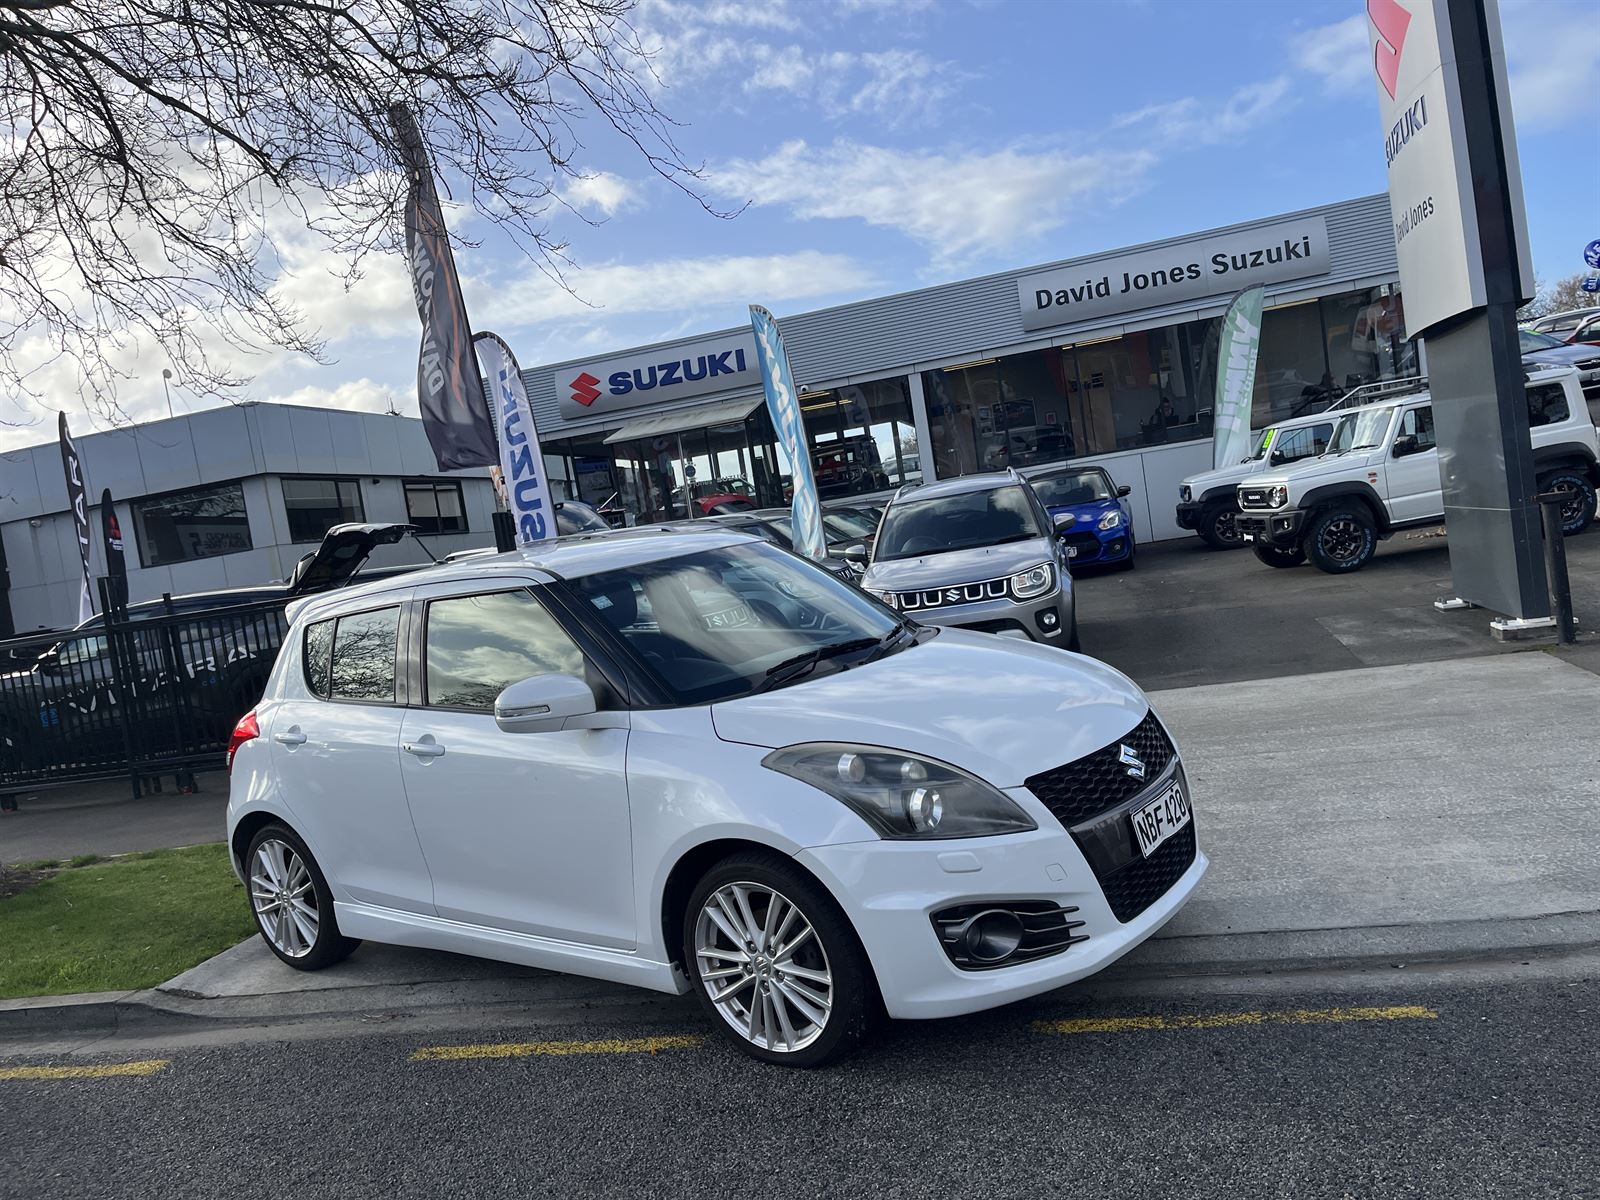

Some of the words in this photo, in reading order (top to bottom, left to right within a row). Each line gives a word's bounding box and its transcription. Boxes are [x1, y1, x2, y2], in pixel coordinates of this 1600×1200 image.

[1410, 196, 1434, 230] Jones
[1035, 277, 1111, 310] David
[1120, 262, 1201, 294] Jones
[1210, 236, 1311, 276] Suzuki
[608, 348, 747, 395] SUZUKI
[1136, 805, 1163, 850] NBF
